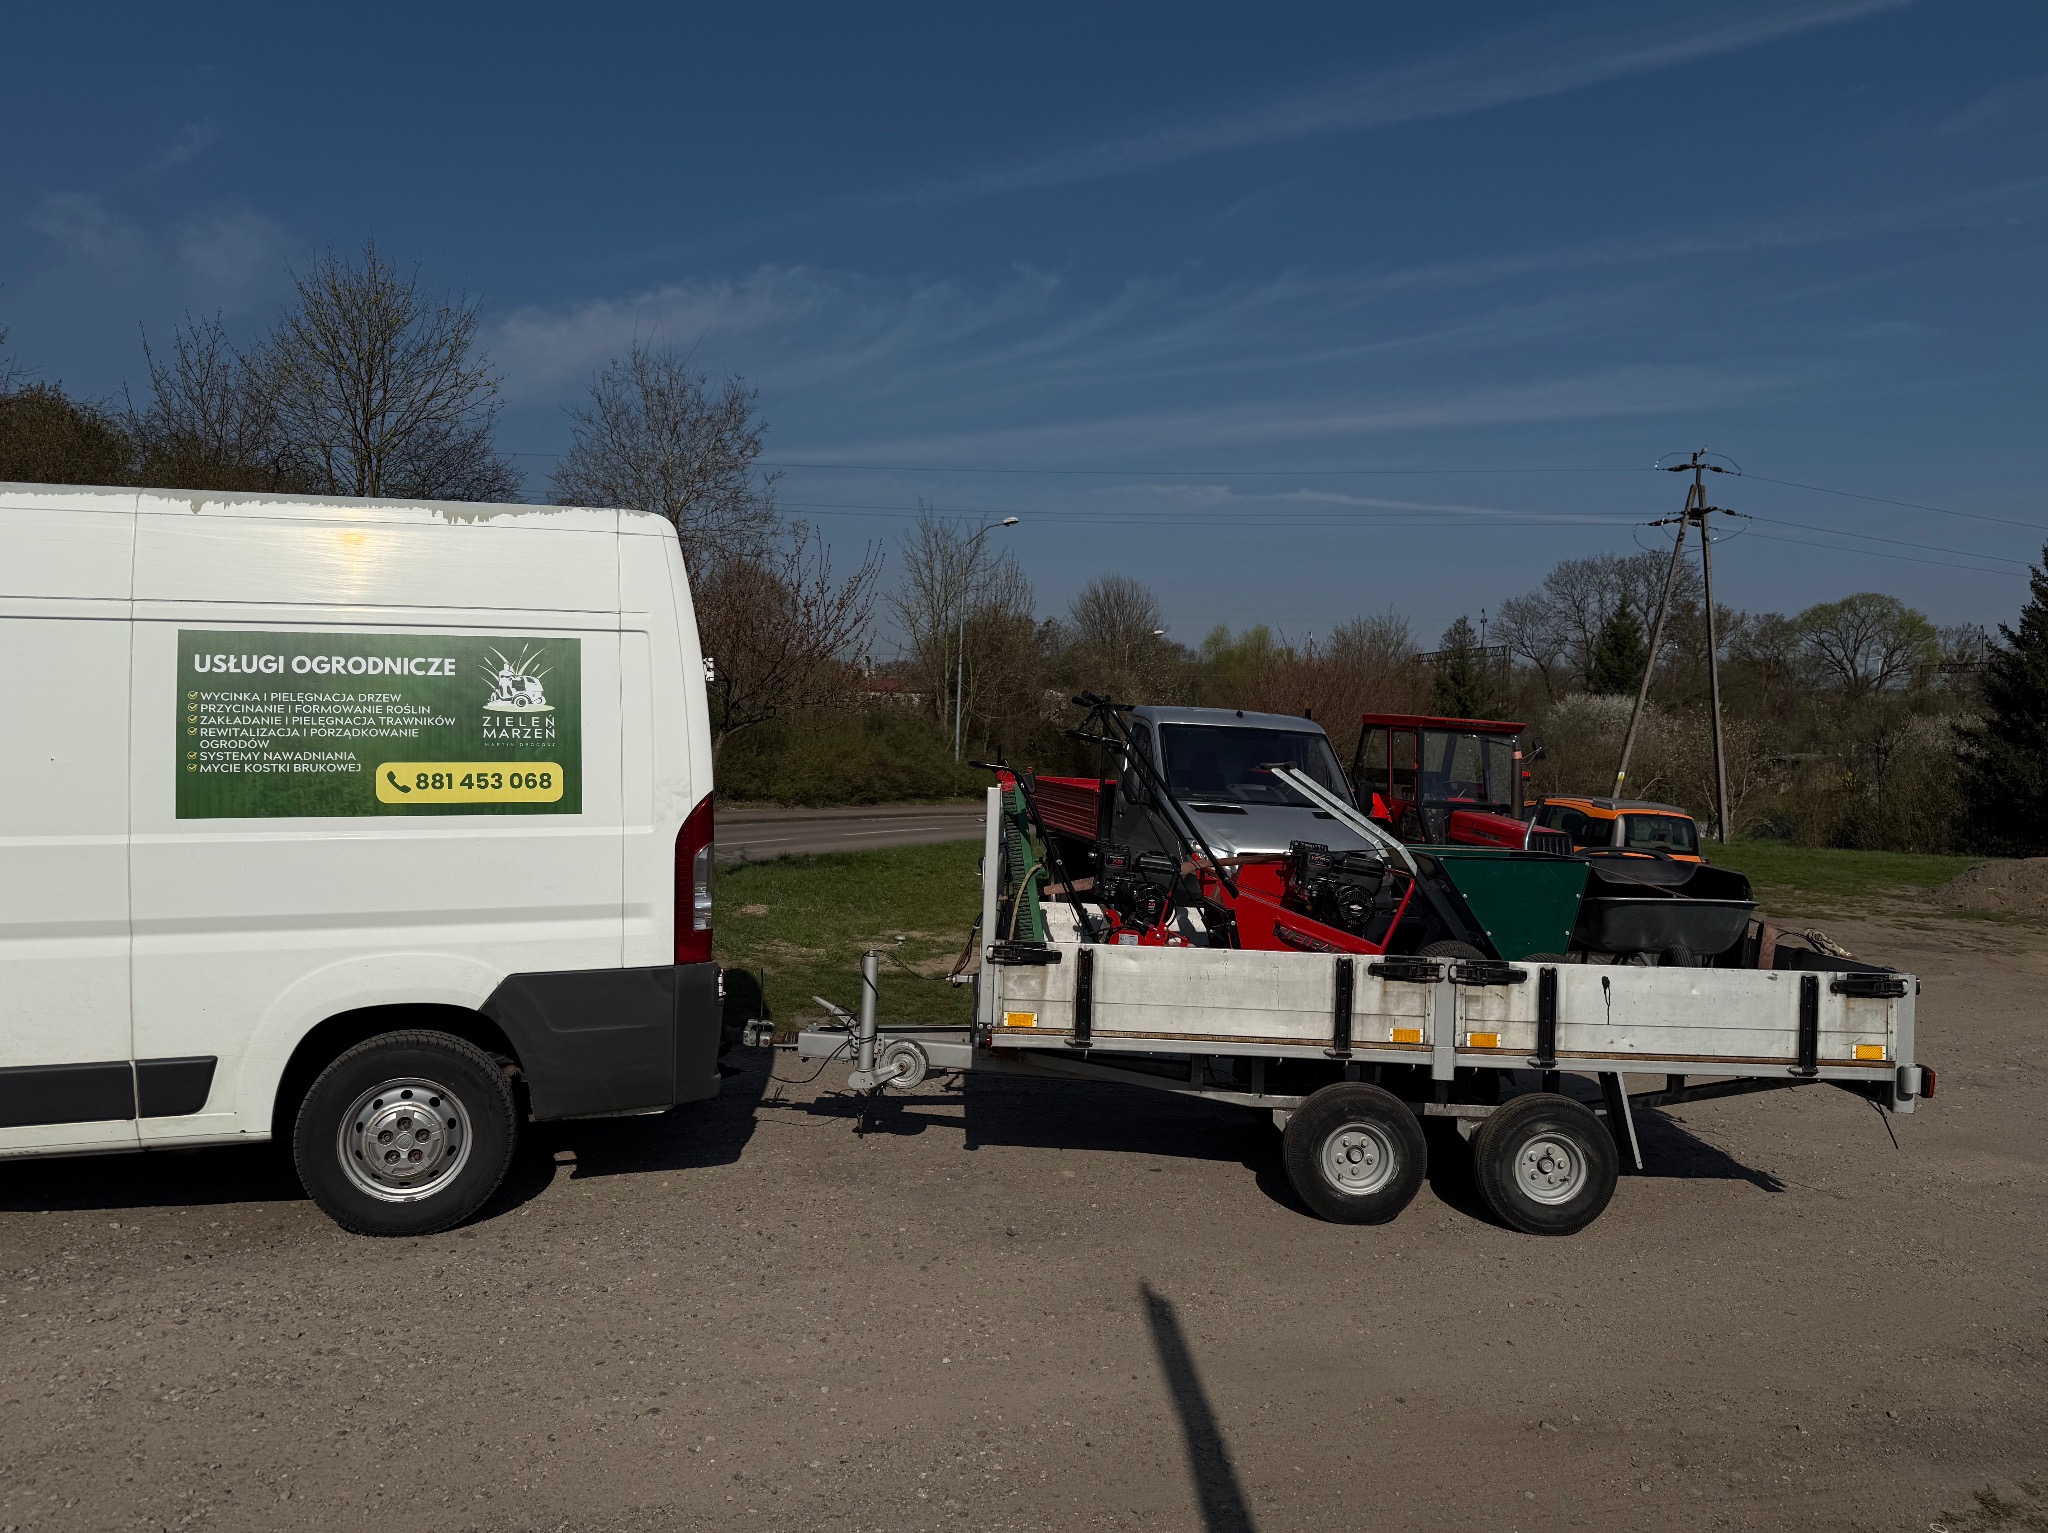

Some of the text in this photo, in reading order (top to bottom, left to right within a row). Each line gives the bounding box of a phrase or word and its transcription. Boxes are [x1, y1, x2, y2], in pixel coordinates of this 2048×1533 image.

[194, 654, 456, 676] USŁUGI OGRODNICZE
[200, 692, 260, 702] WYCINKA
[271, 692, 355, 704] PIELĘGNACJA
[359, 693, 401, 702] DRZEW
[200, 704, 284, 713] PRZYCINANIE
[295, 704, 383, 714] FORMOWANIE
[386, 703, 431, 714] ROŚLIN
[200, 716, 282, 725] ZAKŁADANIE
[292, 716, 376, 727] PIELĘGNACJA
[379, 715, 456, 726] TRAWNIKÓW
[482, 714, 555, 727] ZIELEŃ
[200, 728, 300, 737] REWITALIZACJA
[310, 728, 419, 739] PORZĄDKOWANIE
[483, 726, 555, 739] MARZEŃ
[200, 738, 270, 749] OGRODÓW
[200, 751, 356, 761] SYSTEMY NAWADNIANIA
[200, 763, 361, 773] MYCIE KOSTKI BRUKOWEJ
[416, 773, 552, 790] 881 453 068
